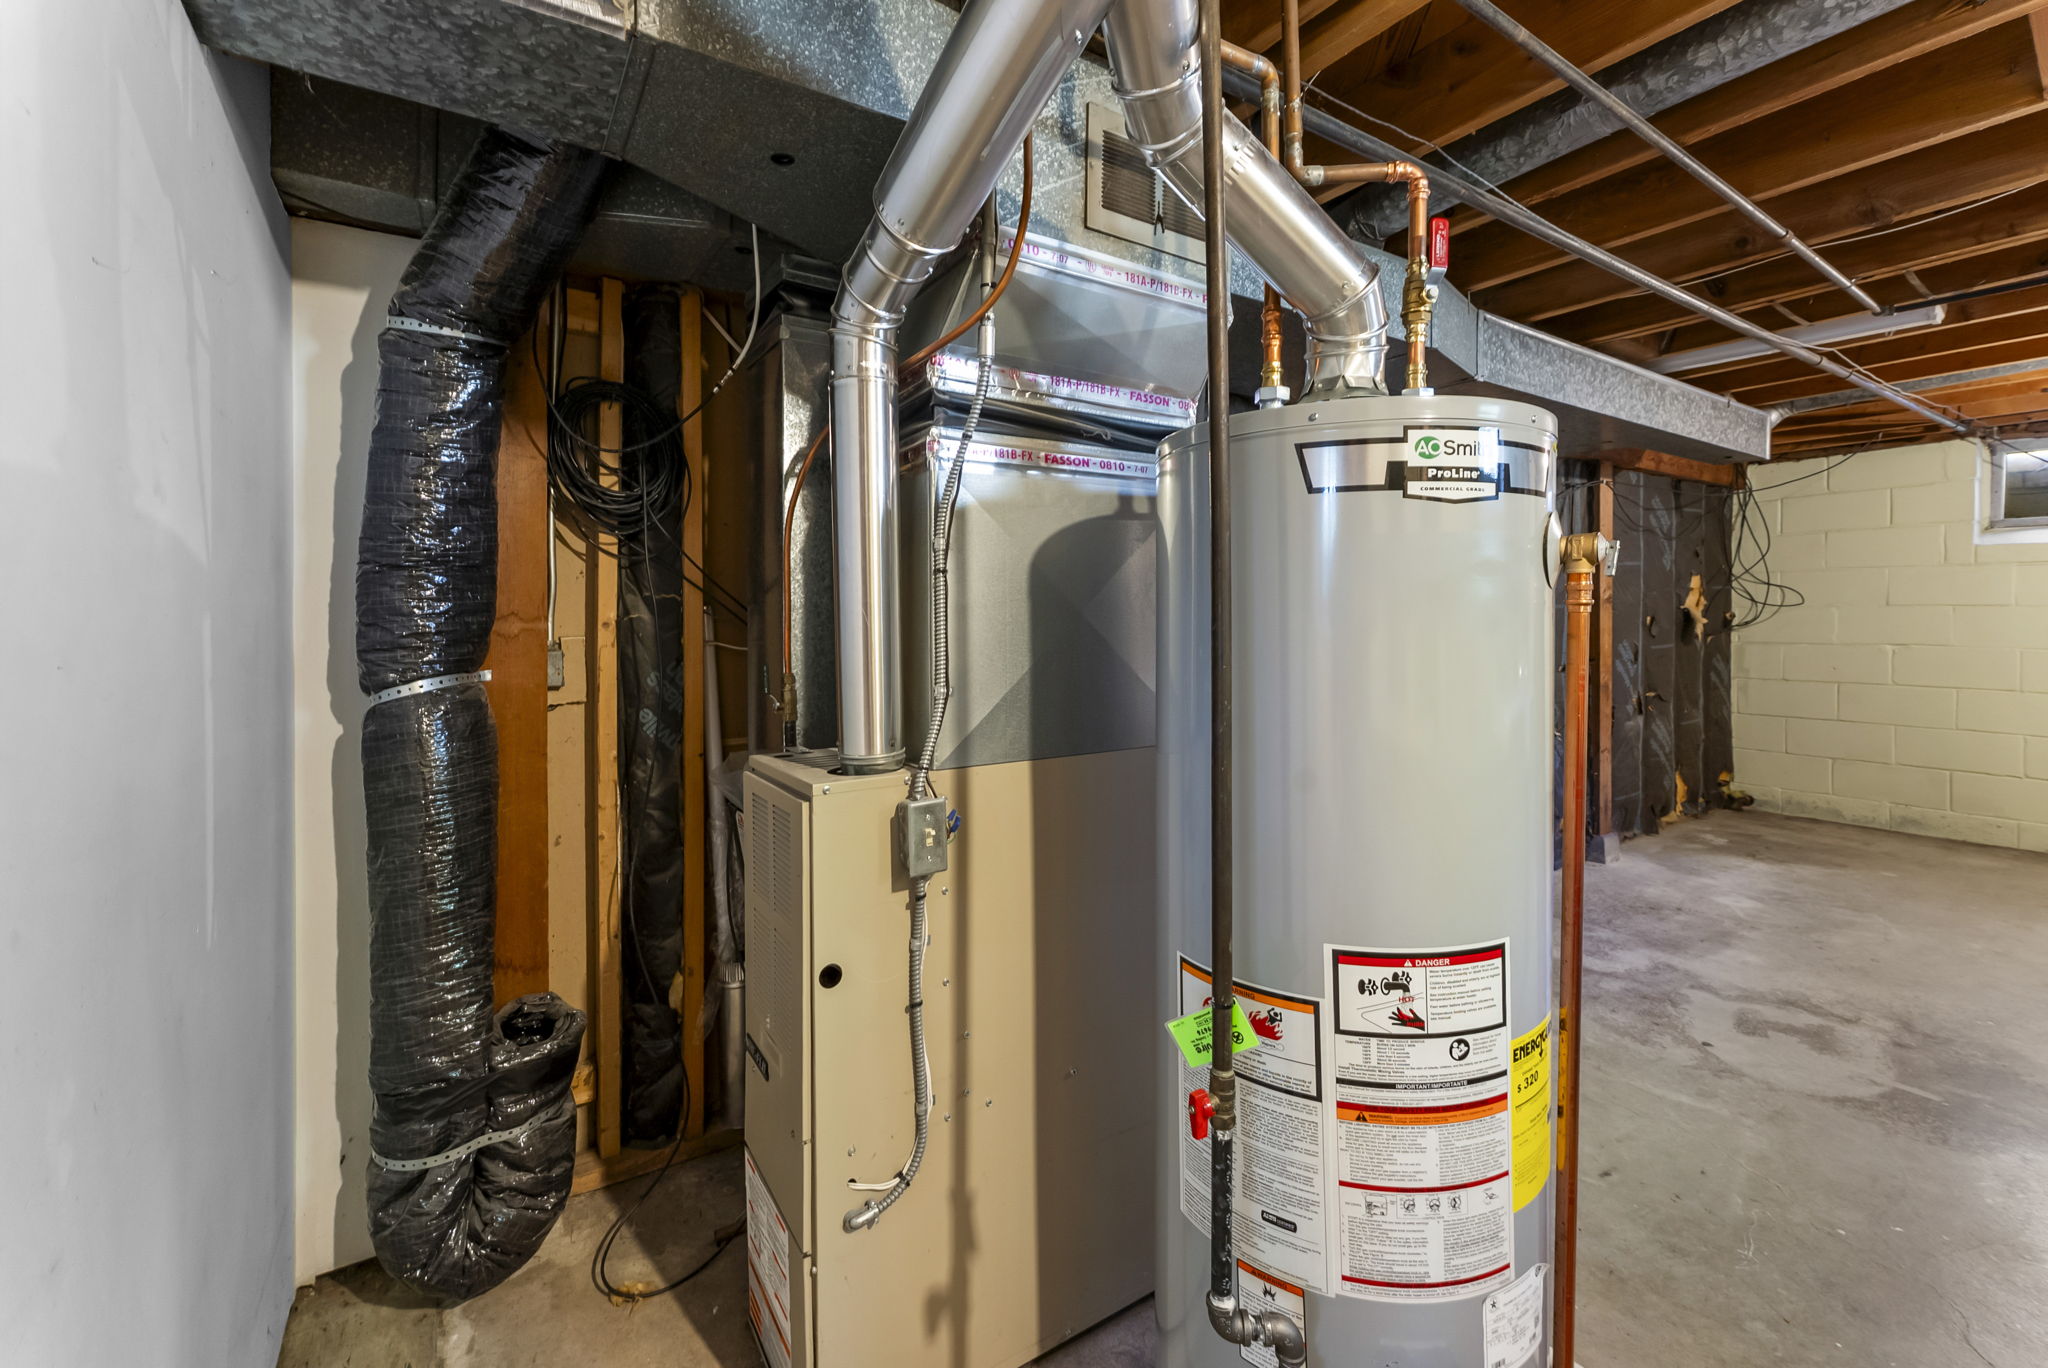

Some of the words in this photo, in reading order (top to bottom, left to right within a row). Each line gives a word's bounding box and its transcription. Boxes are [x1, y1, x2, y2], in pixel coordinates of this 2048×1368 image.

[1129, 391, 1170, 407] FASSON
[1044, 453, 1090, 468] FASSON
[1099, 460, 1125, 472] 0810
[1427, 467, 1479, 479] ProLine
[1415, 958, 1450, 967] DANGER
[1523, 1070, 1539, 1090] 320
